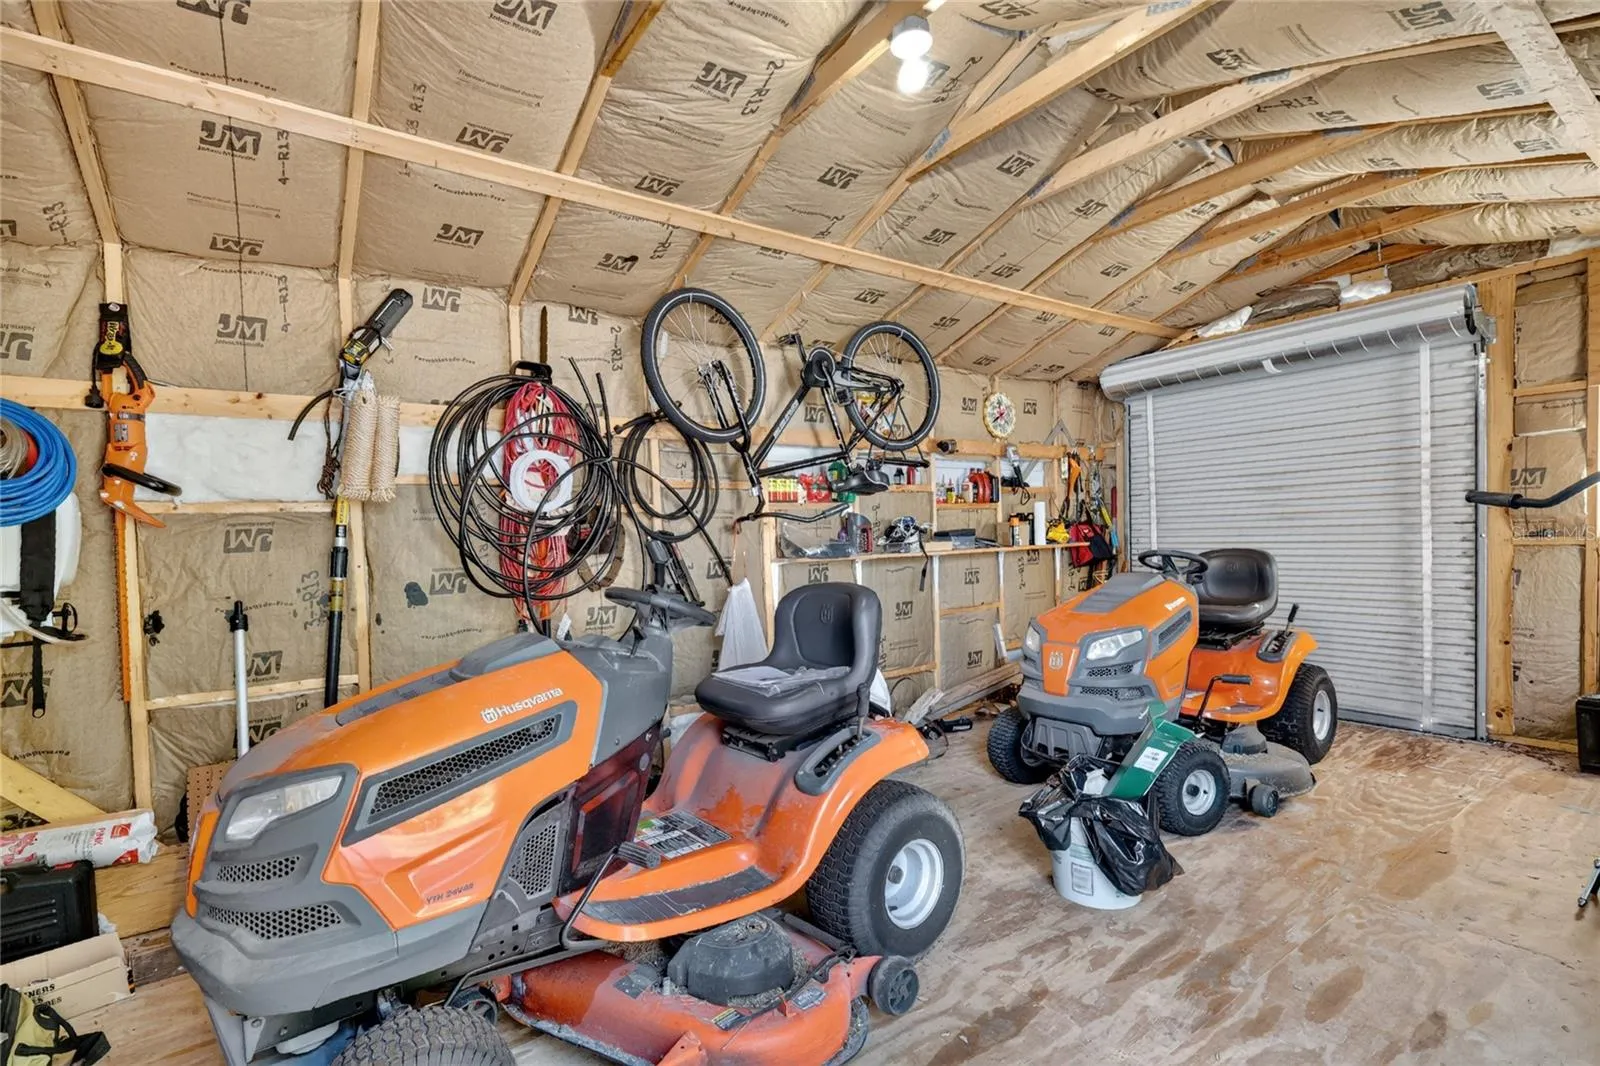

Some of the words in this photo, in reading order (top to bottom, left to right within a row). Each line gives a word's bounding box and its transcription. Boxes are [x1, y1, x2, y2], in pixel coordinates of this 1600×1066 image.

[200, 120, 262, 156] JM
[456, 126, 511, 153] JM
[209, 236, 263, 256] JM
[436, 223, 485, 246] JM
[422, 287, 462, 313] JM
[217, 313, 268, 342] JM
[1511, 467, 1547, 487] JM
[223, 528, 274, 554] JM
[585, 606, 618, 626] JM
[495, 687, 564, 718] Husqvarna
[24, 983, 56, 999] NERS
